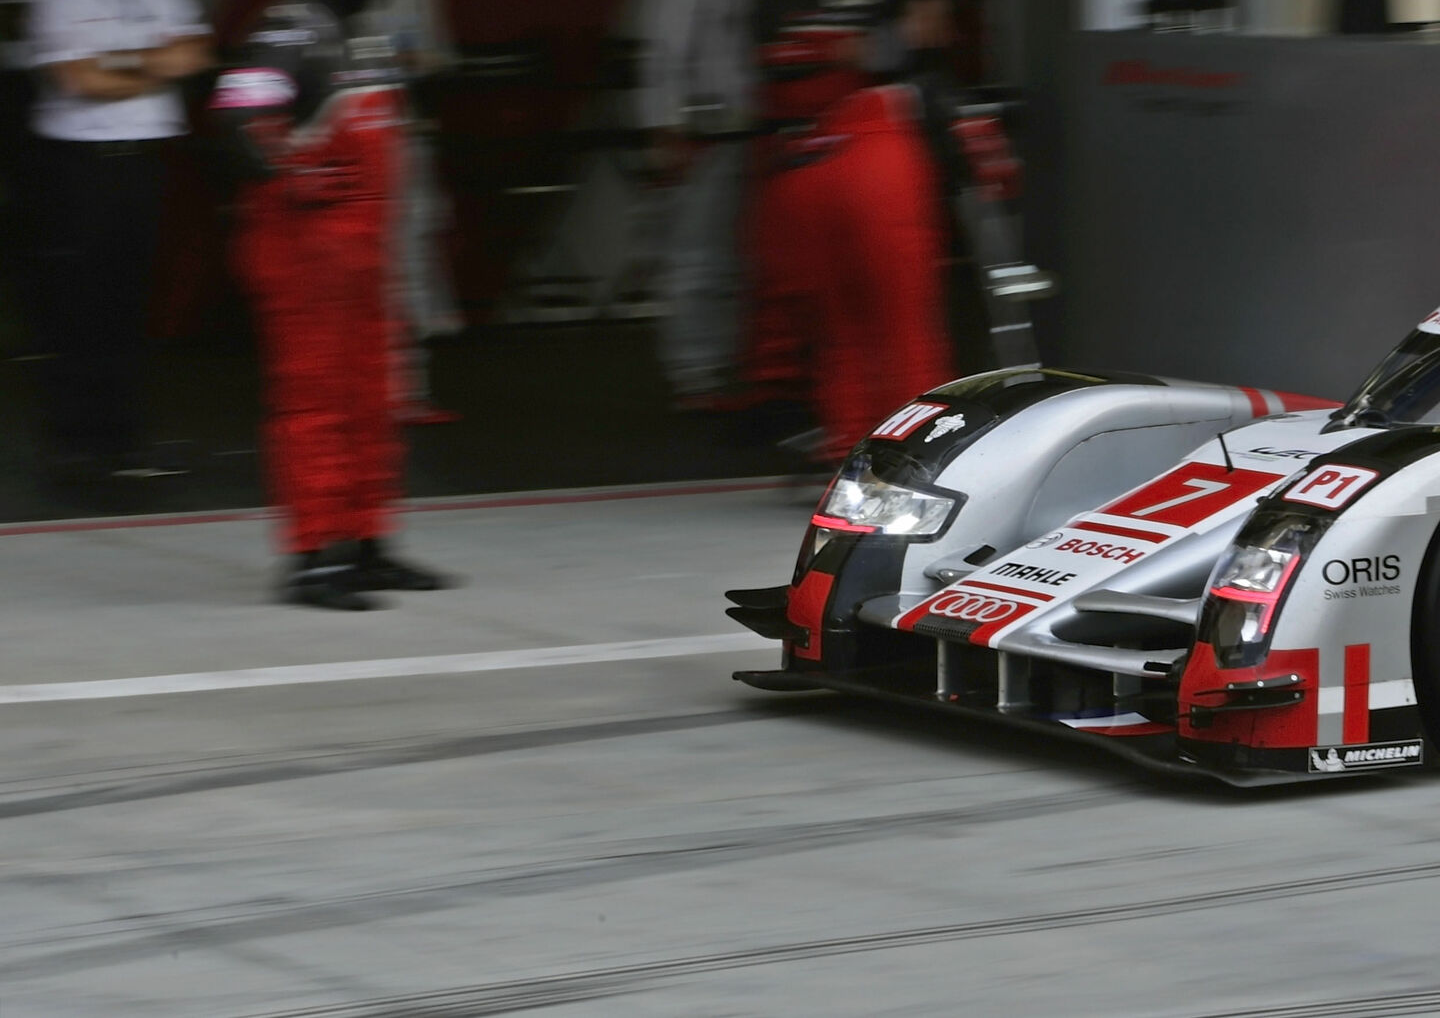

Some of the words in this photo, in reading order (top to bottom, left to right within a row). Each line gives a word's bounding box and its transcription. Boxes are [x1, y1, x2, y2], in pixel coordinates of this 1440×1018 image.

[872, 404, 944, 437] HY
[1130, 478, 1232, 517] 7
[1300, 470, 1361, 500] P1
[1055, 538, 1147, 564] BOSCH
[989, 562, 1077, 586] MAHLE
[1322, 554, 1401, 586] ORIS
[1324, 588, 1356, 600] Swiss
[1359, 584, 1401, 598] Watches
[1344, 745, 1420, 762] MICHELIN
